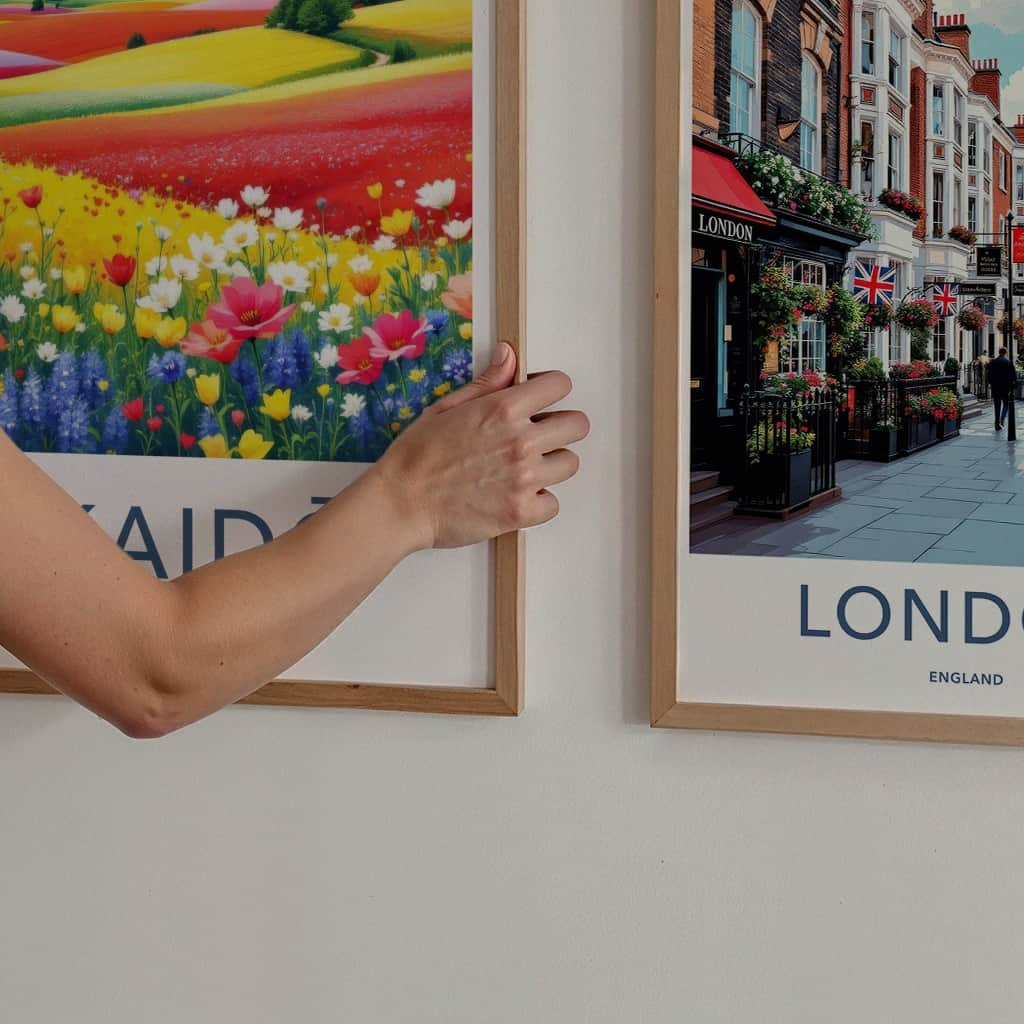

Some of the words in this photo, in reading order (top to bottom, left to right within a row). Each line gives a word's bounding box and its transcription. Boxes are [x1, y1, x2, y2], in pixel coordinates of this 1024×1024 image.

[699, 213, 753, 241] LONDON
[799, 584, 1024, 644] LOND
[928, 671, 1004, 686] ENGLAND
